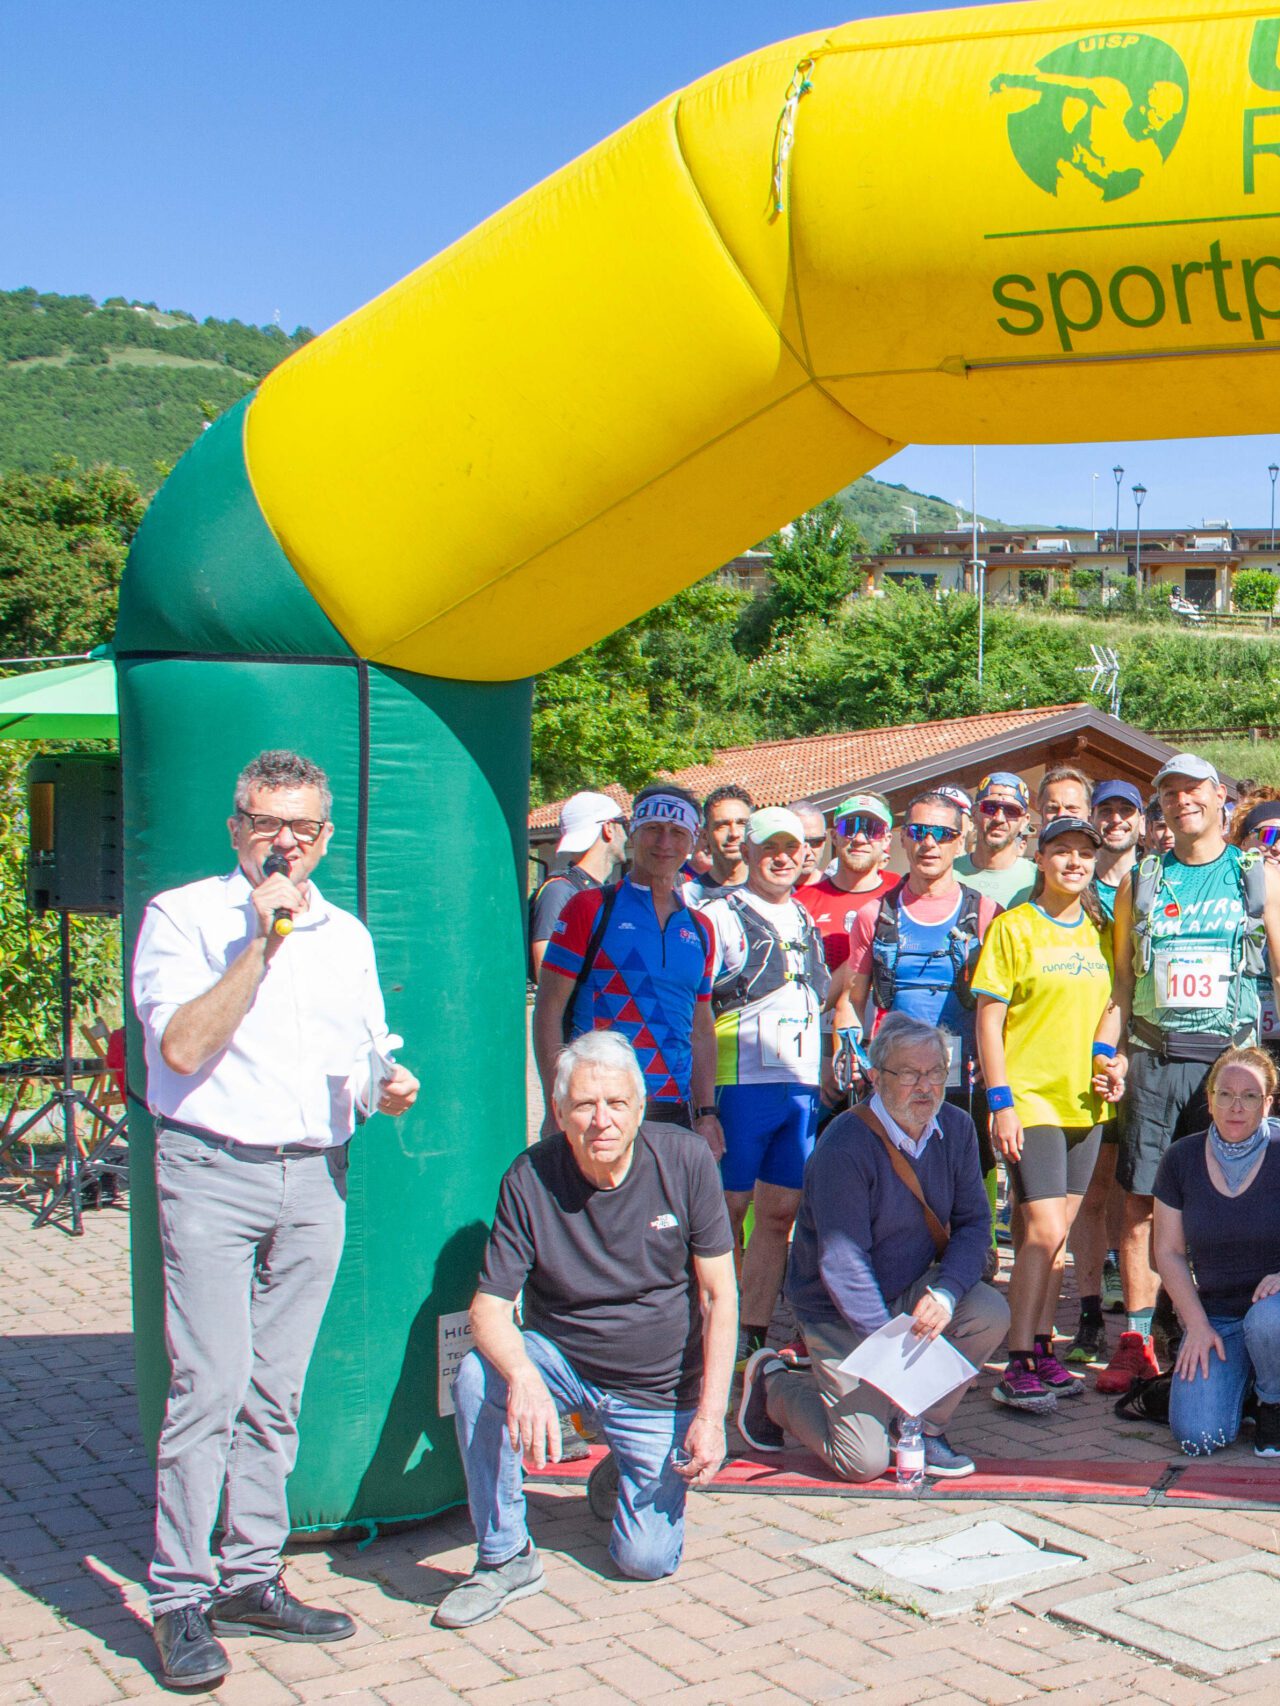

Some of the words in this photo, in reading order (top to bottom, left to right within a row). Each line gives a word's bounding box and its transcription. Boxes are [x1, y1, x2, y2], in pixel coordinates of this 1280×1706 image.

[1078, 34, 1140, 53] UISP
[1170, 973, 1213, 998] 103
[792, 1031, 803, 1058] 1
